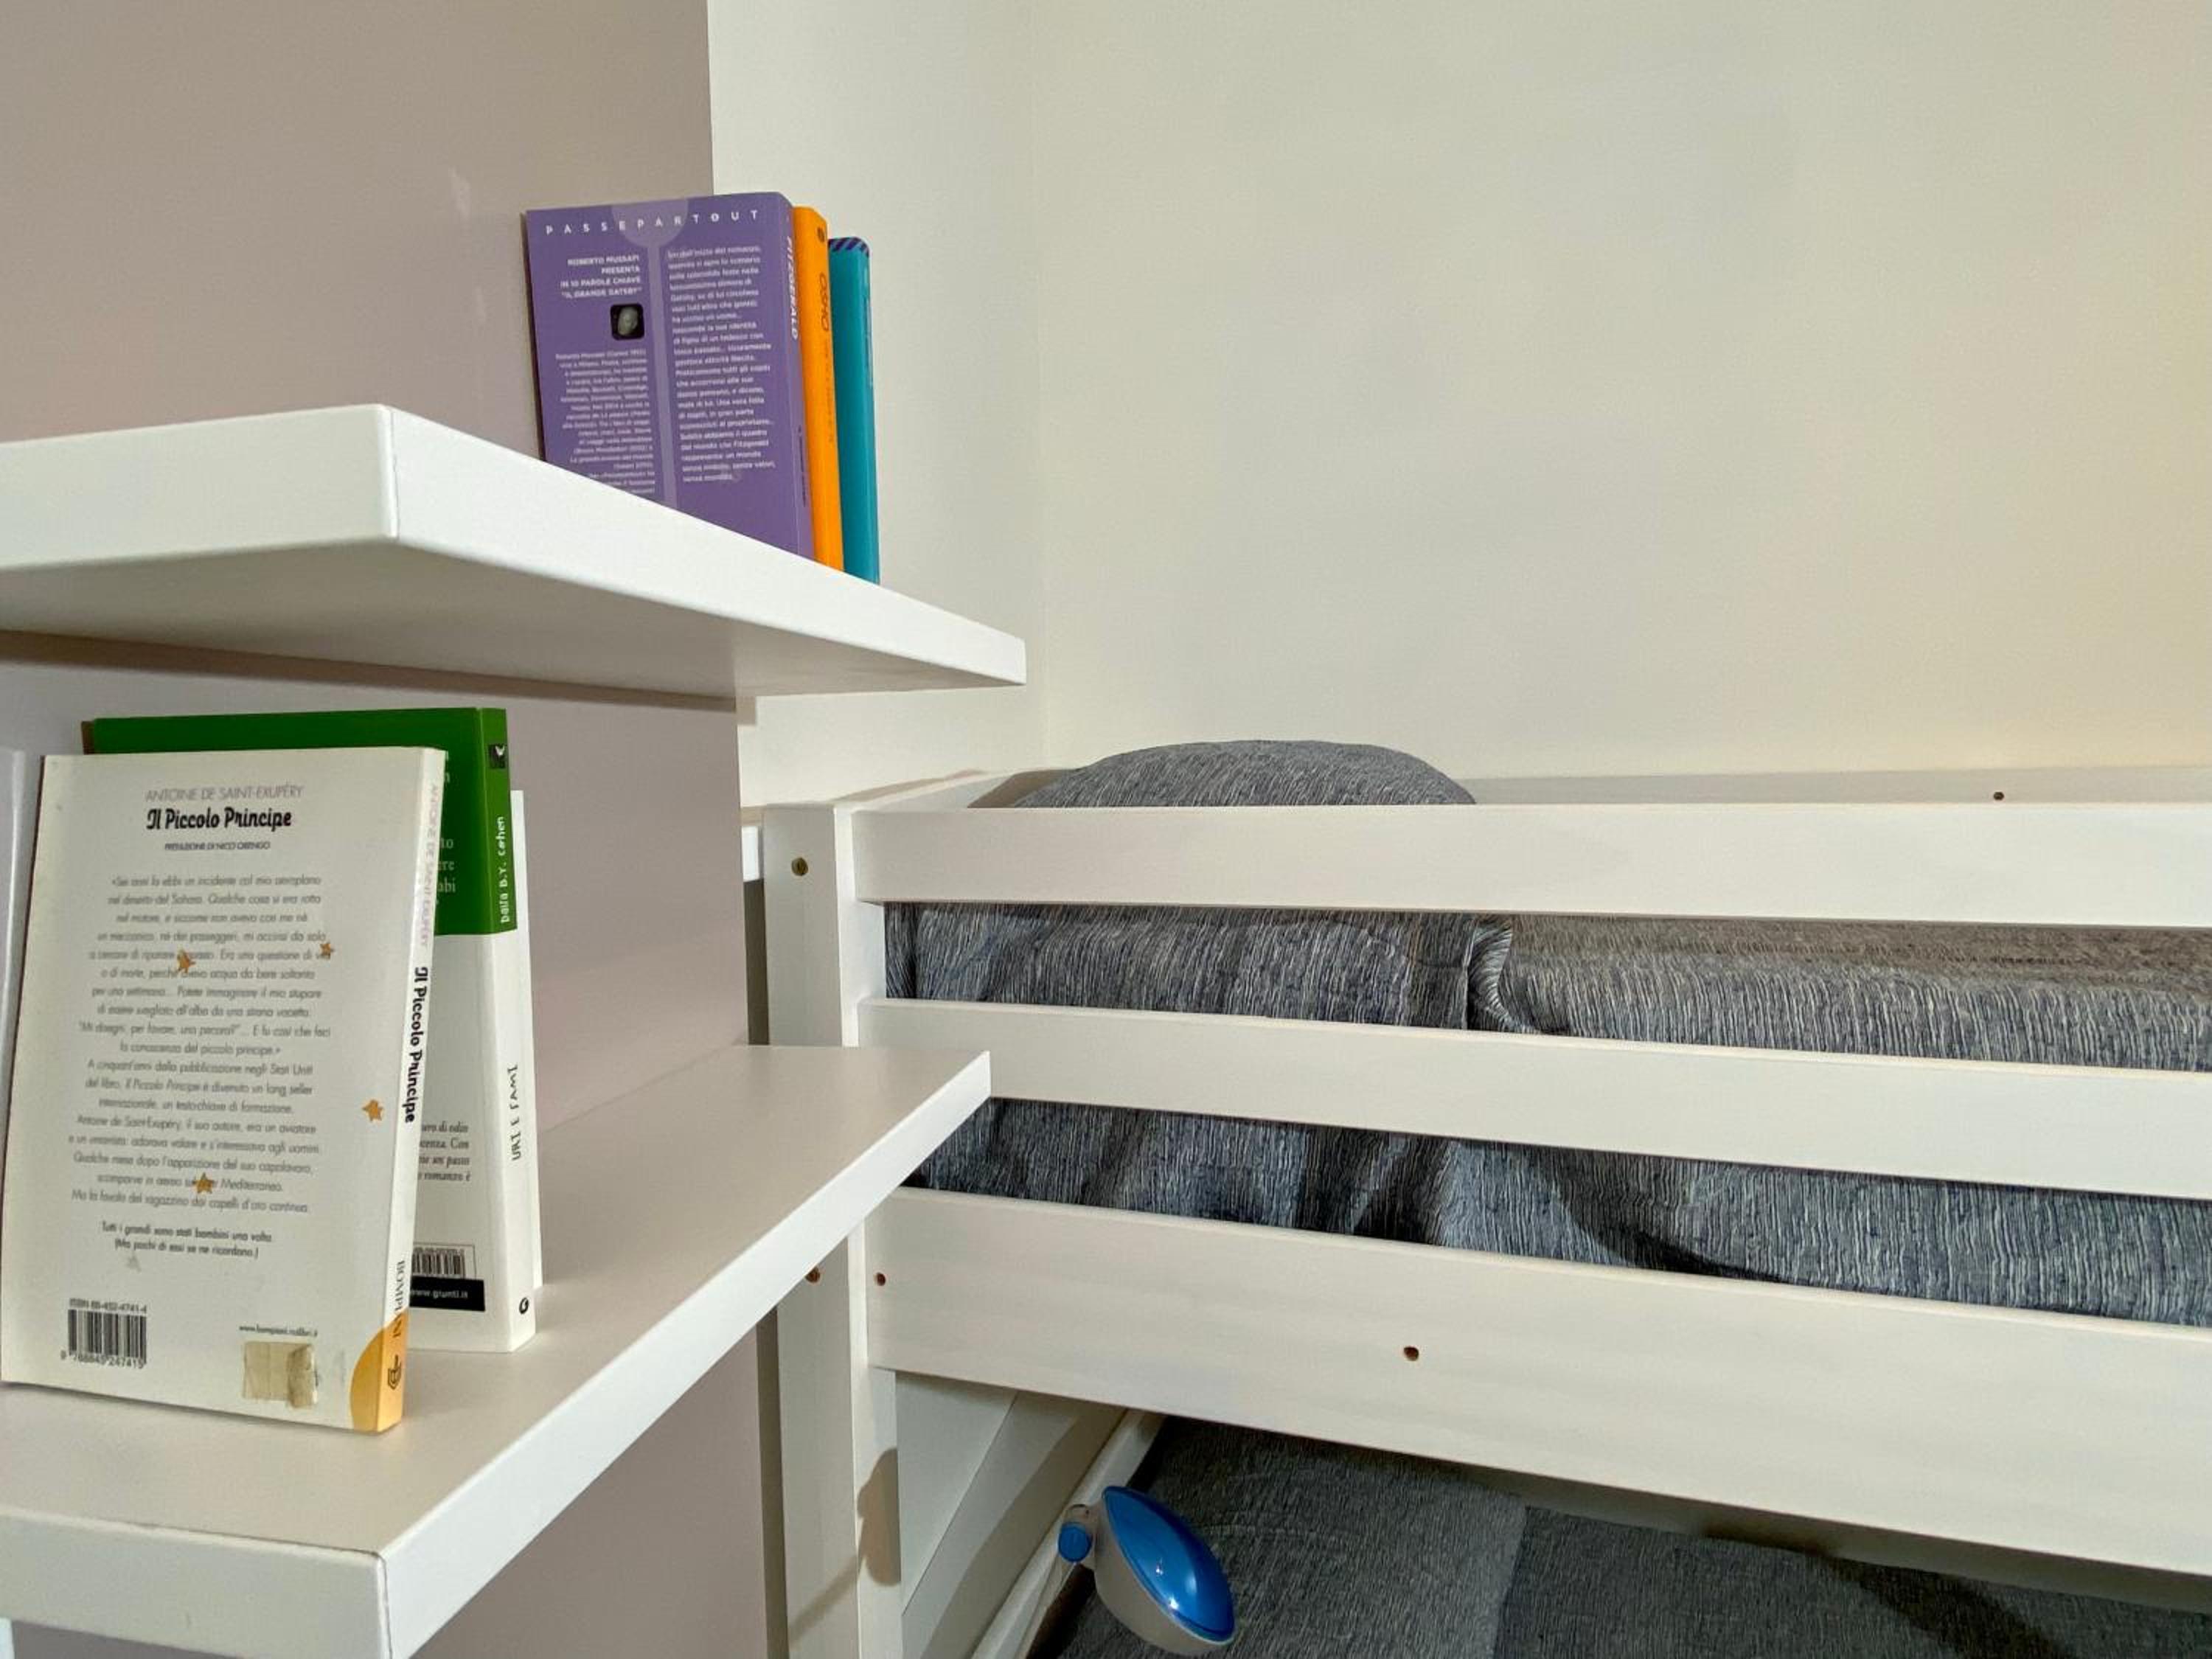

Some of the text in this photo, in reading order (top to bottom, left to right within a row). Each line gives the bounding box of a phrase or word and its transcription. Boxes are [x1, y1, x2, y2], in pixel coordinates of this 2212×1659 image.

[546, 209, 758, 235] PASSEPARTOUT
[566, 257, 605, 266] ROBERTO
[601, 265, 640, 275] PRESENTA
[580, 277, 611, 287] PAROLE
[613, 275, 641, 285] CHIAVE
[786, 235, 799, 341] FITZGERALD
[574, 288, 607, 298] GRANDE
[818, 273, 830, 333] OSHO
[145, 788, 197, 802] ANTOINE
[201, 787, 214, 801] DE
[146, 806, 292, 832] Il Piccolo Principe
[402, 967, 428, 1124] Il Piccolo Principe
[125, 1224, 151, 1236] grandi
[195, 1227, 229, 1239] bambini
[232, 1233, 248, 1241] una
